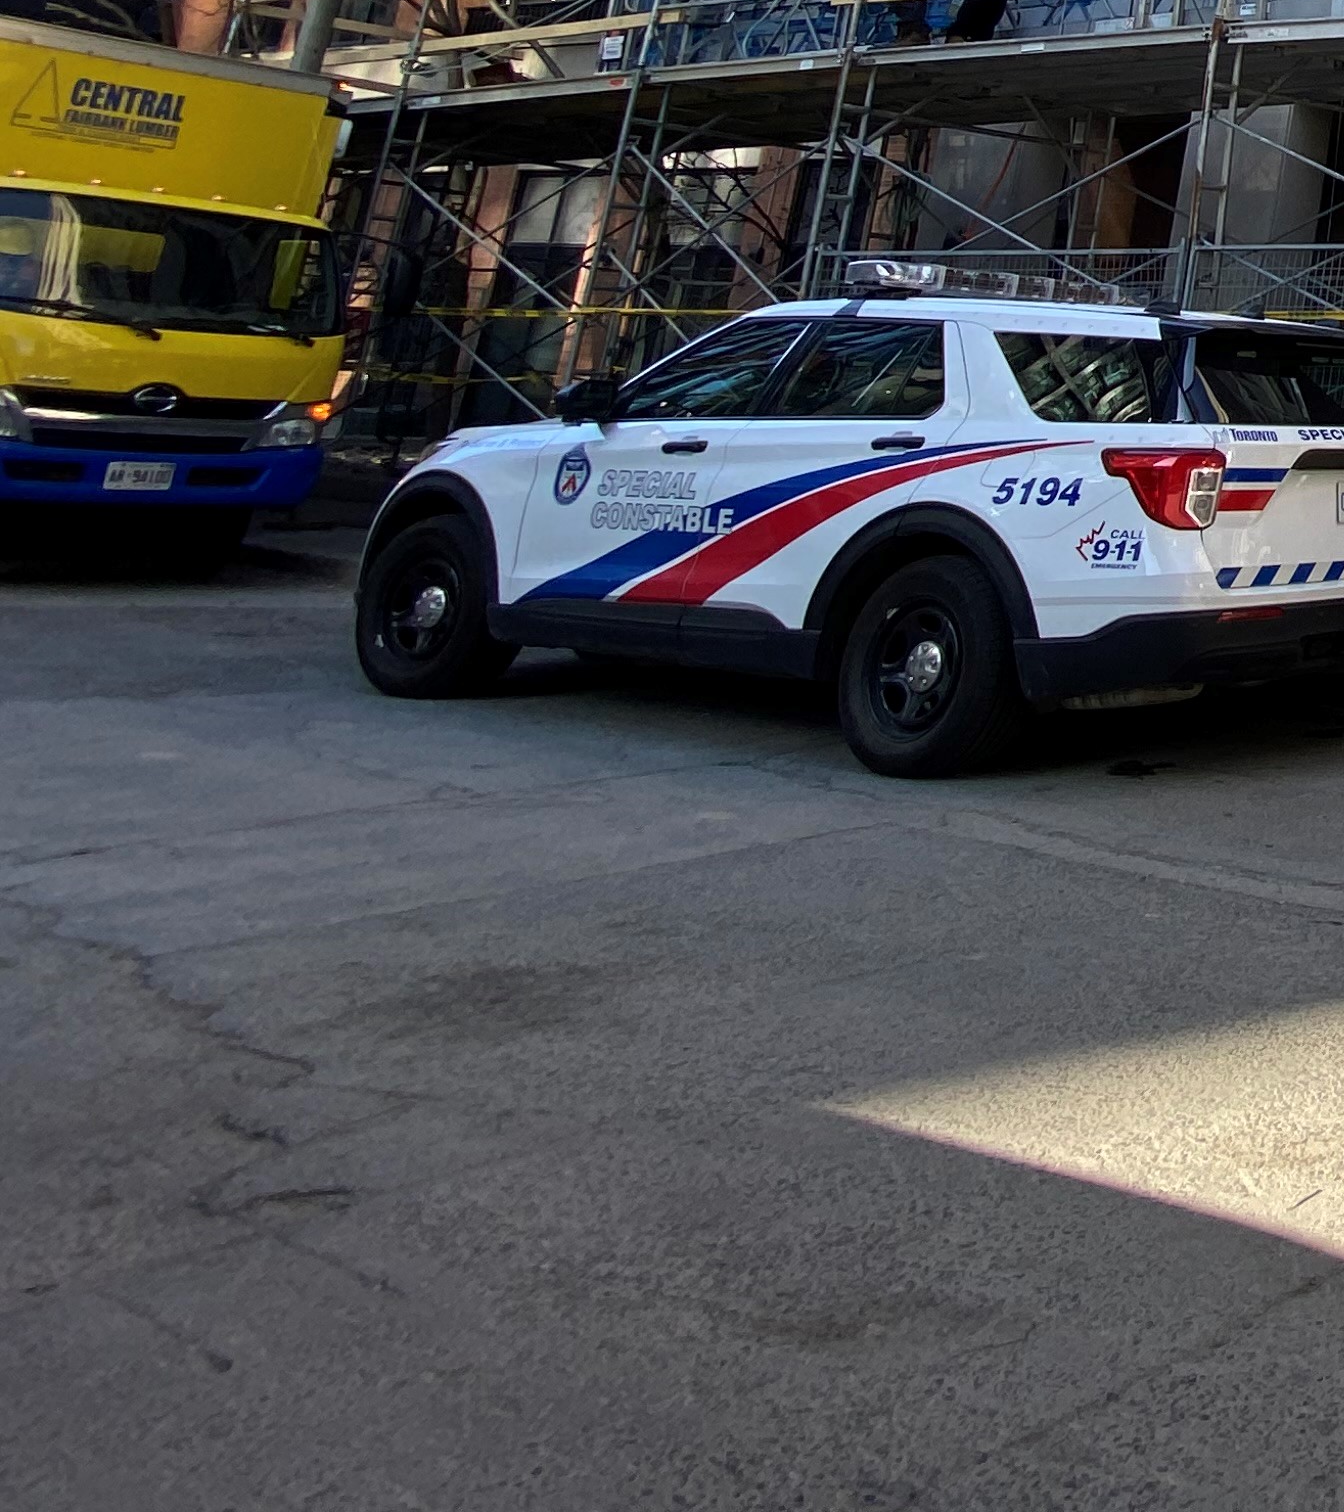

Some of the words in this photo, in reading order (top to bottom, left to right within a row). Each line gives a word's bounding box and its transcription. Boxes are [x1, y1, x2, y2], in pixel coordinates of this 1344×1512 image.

[70, 78, 186, 123] CENTRAL
[1229, 428, 1279, 442] TORONTO
[597, 468, 698, 500] SPECIAL
[992, 477, 1084, 507] 5194
[590, 501, 734, 535] CONSTABLE
[1110, 529, 1144, 540] CALL
[1092, 538, 1143, 562] 9-1-1
